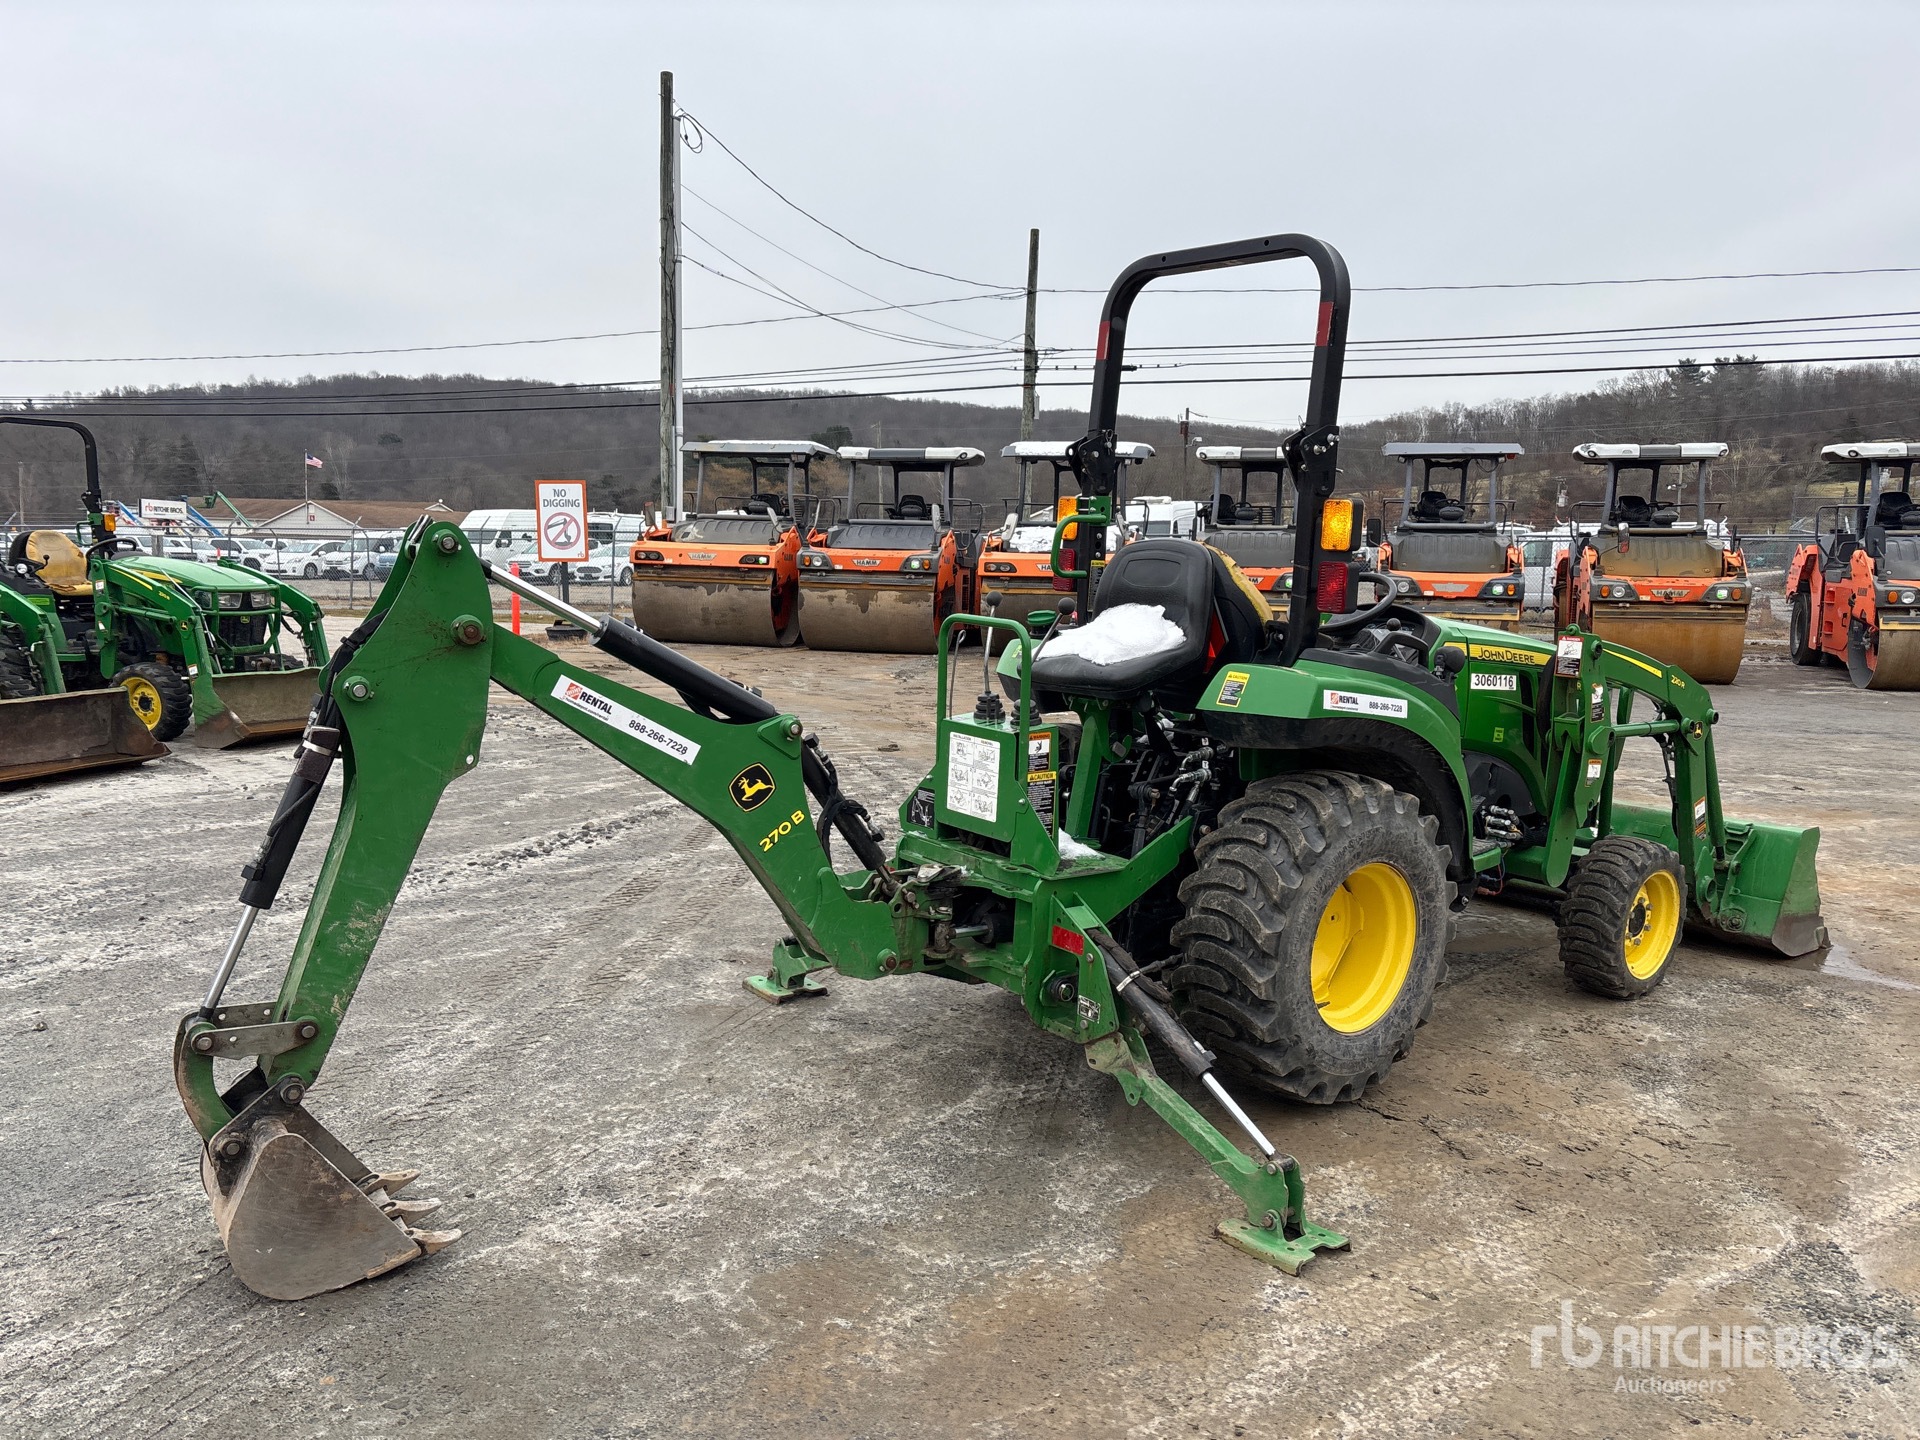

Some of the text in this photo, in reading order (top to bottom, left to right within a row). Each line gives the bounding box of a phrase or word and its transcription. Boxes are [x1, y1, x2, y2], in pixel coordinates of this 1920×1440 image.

[552, 488, 567, 498] NO
[542, 498, 580, 508] DIGGING
[1656, 589, 1684, 597] HAMM
[1478, 647, 1535, 664] JOHN DEERE
[1474, 674, 1514, 687] 3060116
[1339, 695, 1358, 705] RENTAL
[1369, 701, 1403, 713] 888-266-7228
[579, 691, 612, 715] RENTAL
[628, 719, 689, 755] 888-266-7228
[1033, 772, 1053, 780] CAUTION
[759, 810, 805, 852] 270 B
